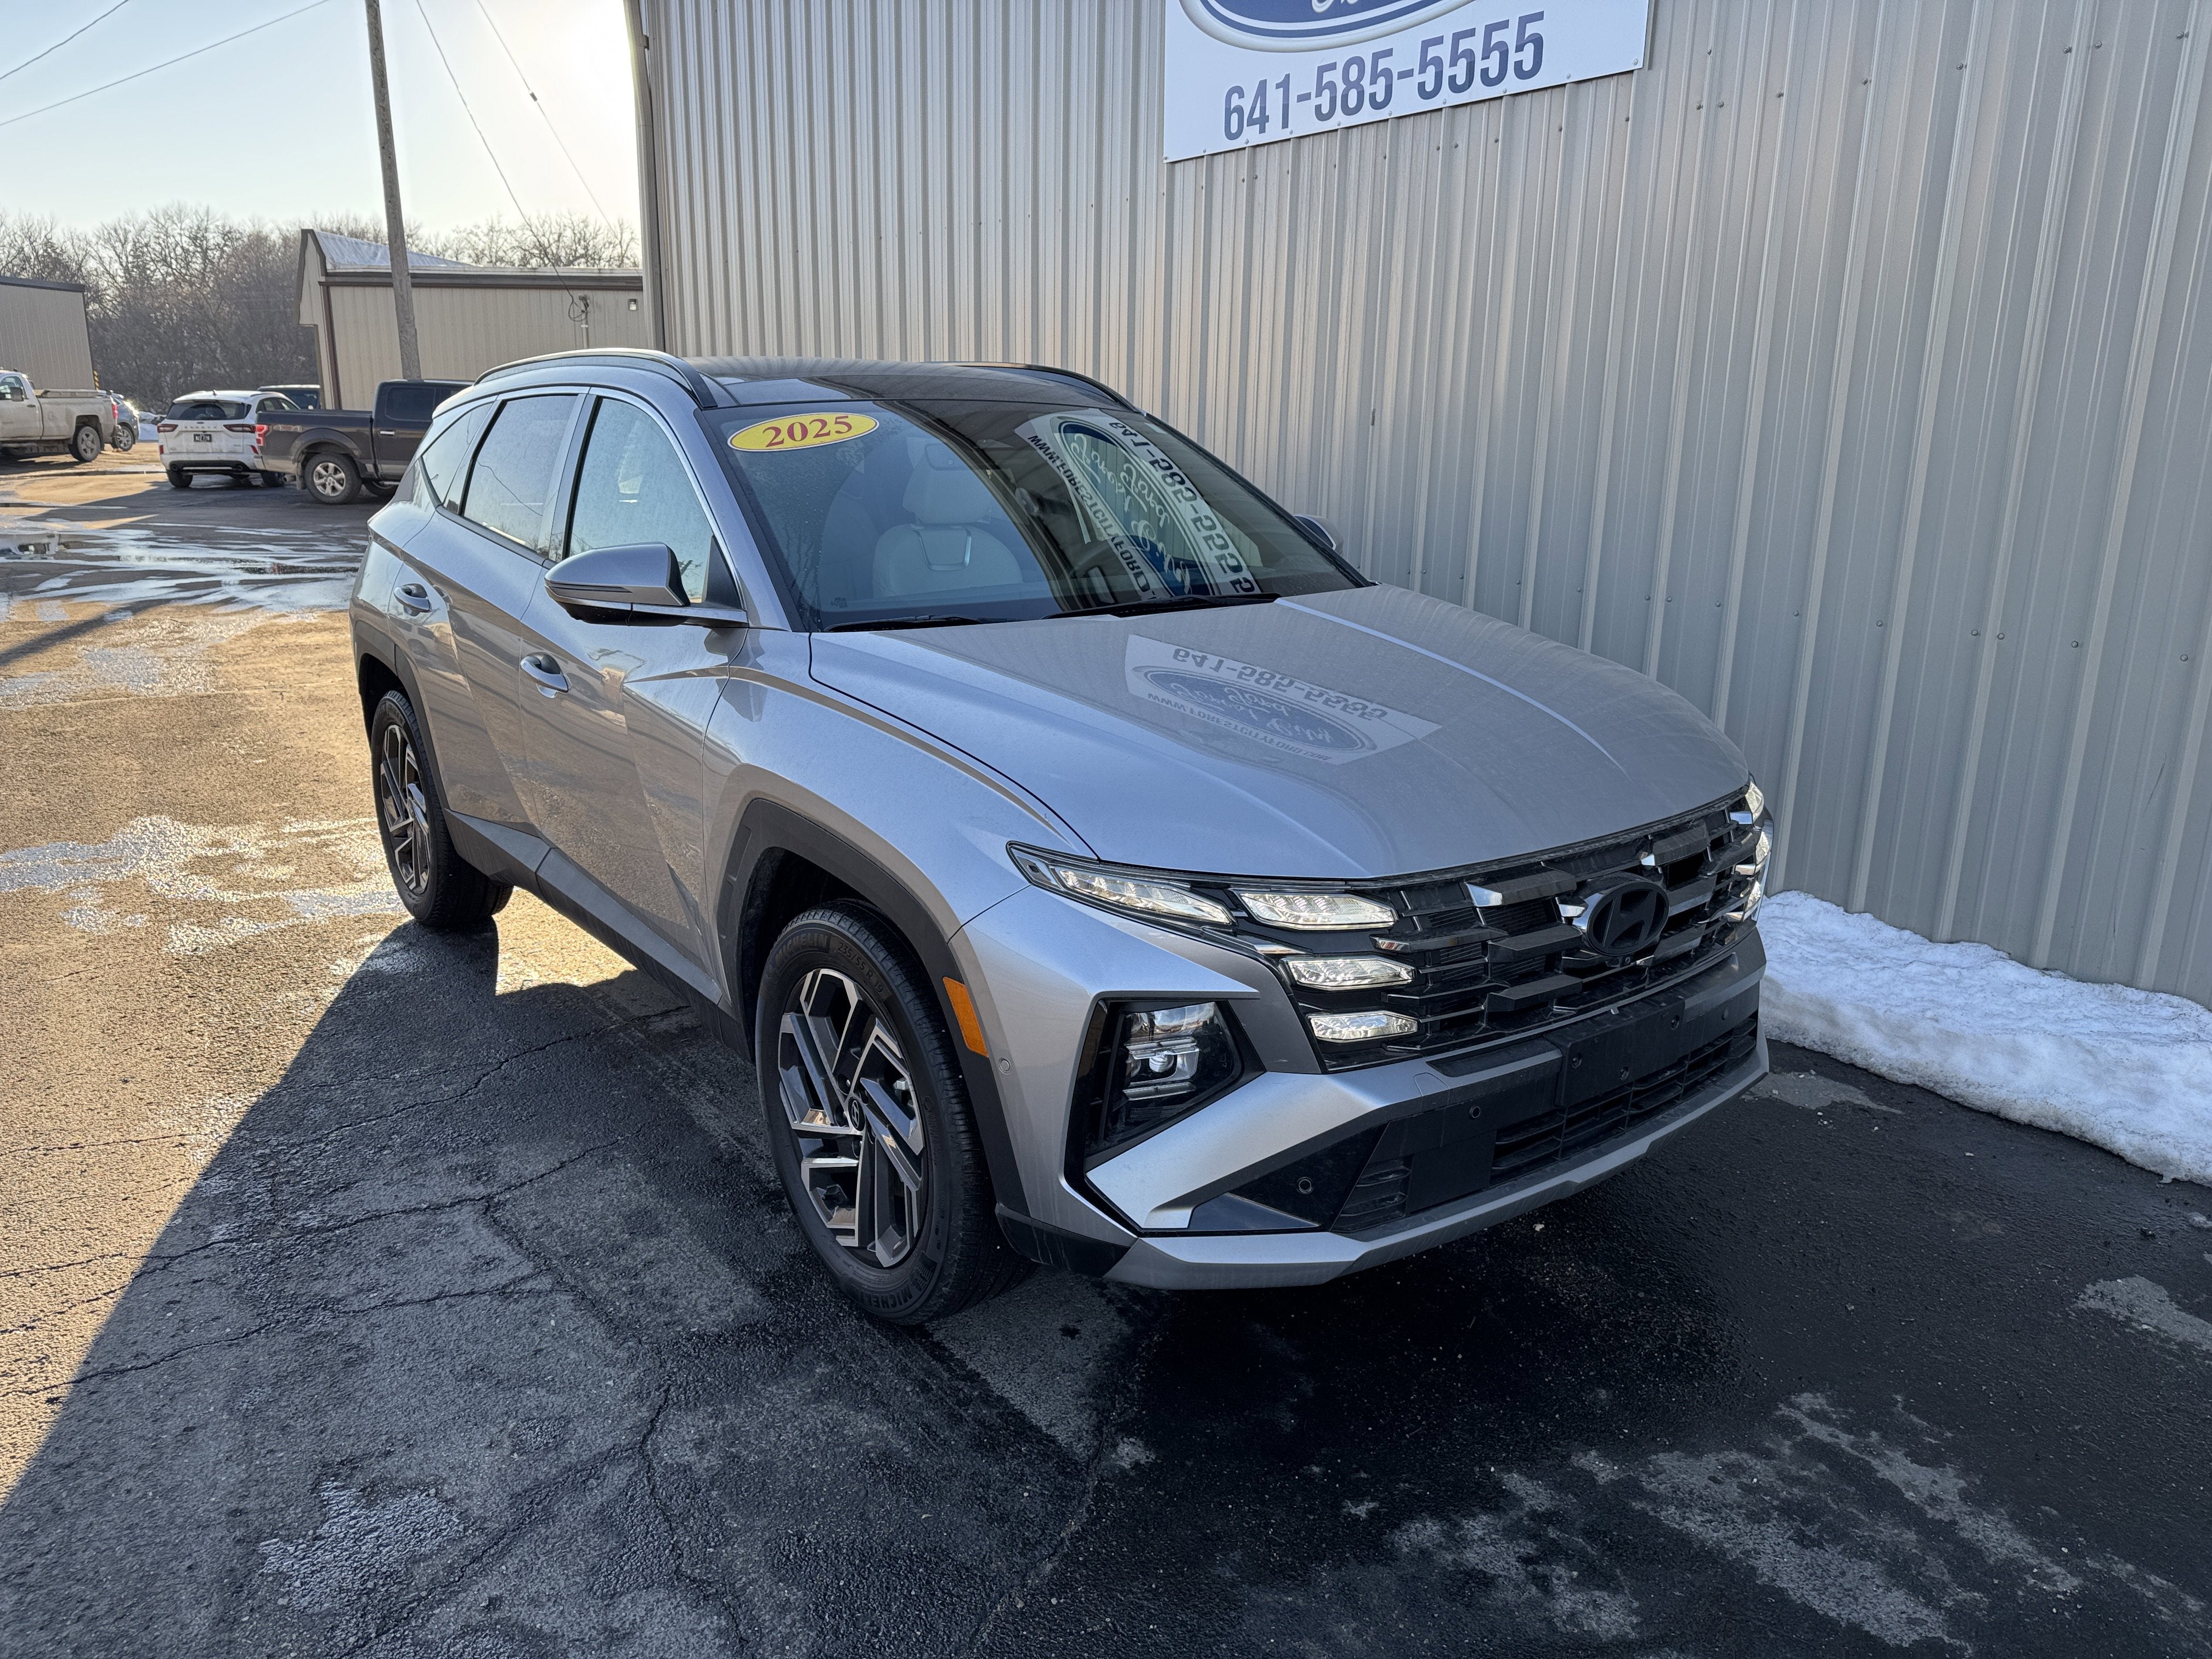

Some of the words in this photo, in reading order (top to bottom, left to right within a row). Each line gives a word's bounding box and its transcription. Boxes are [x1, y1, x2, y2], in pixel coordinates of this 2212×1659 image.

[1224, 11, 1544, 141] 641-585-5555
[763, 415, 852, 447] 2025
[775, 933, 827, 967] MICHELIN
[838, 942, 866, 970] 235/55
[874, 981, 883, 994] 19
